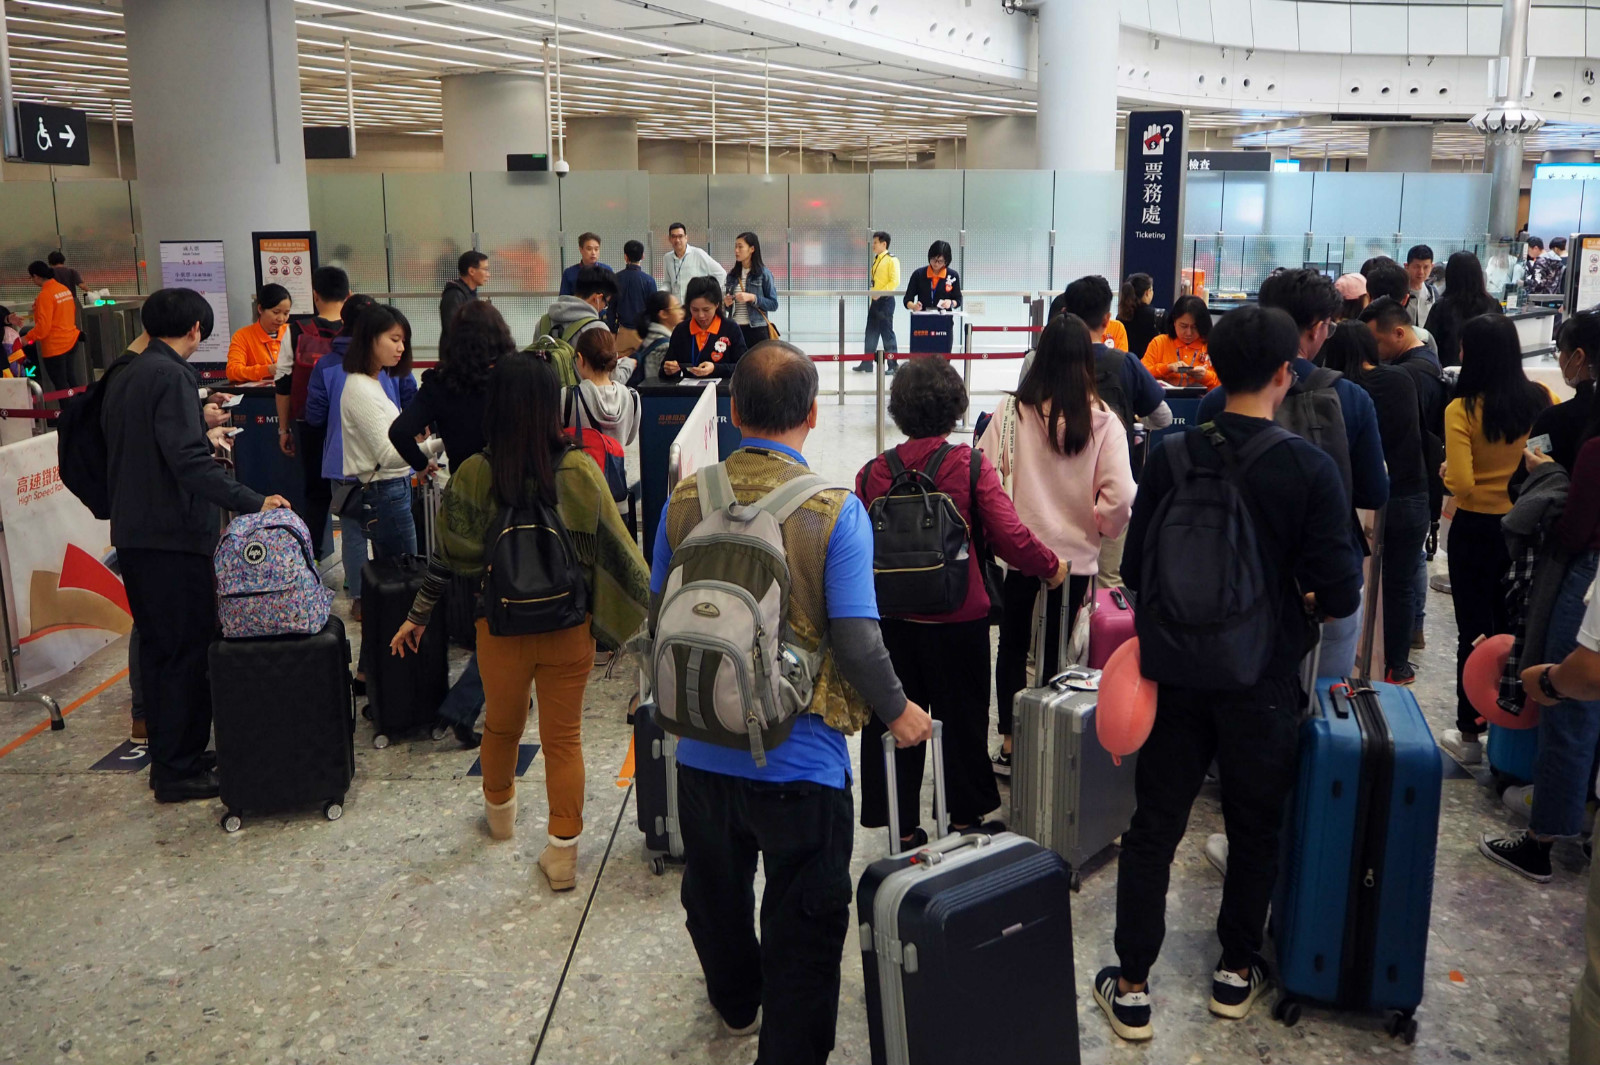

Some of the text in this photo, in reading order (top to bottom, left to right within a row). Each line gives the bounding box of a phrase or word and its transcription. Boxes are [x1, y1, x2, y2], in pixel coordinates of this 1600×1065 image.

[1189, 159, 1210, 170] 檢查
[1141, 161, 1163, 225] 票務處
[1135, 231, 1166, 240] Ticketing
[266, 415, 279, 423] MT
[18, 494, 32, 506] High
[33, 487, 54, 500] Speed
[119, 745, 149, 760] 5
